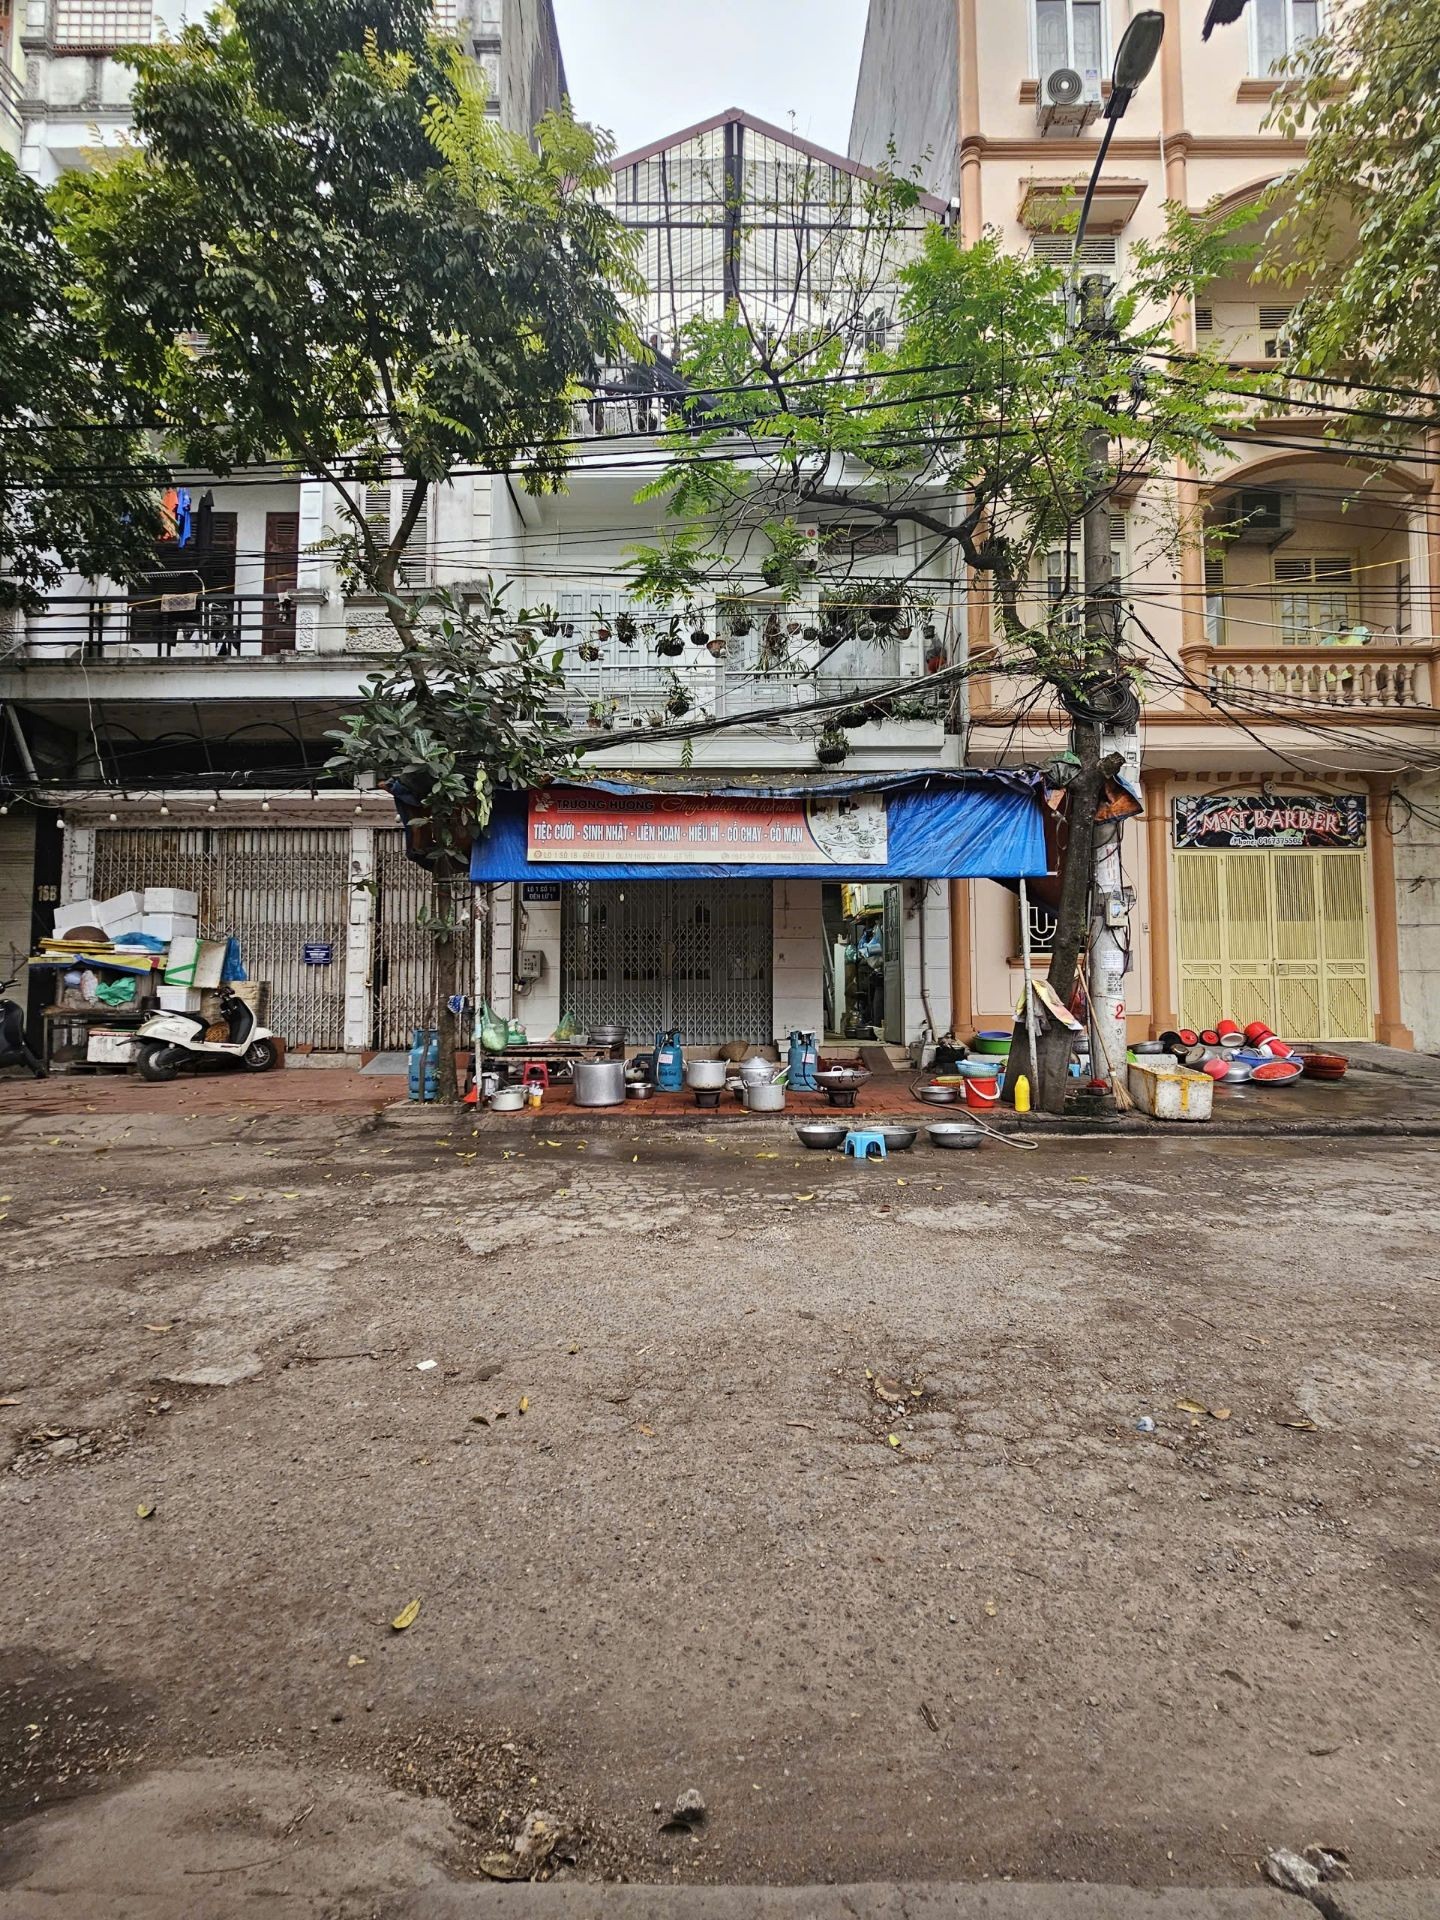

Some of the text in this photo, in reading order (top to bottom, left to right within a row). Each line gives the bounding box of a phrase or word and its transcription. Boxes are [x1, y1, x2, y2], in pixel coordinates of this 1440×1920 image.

[1254, 809, 1341, 833] BARBER
[534, 821, 552, 843] TIỆC
[554, 821, 575, 841] CƯỚI
[582, 825, 604, 841] SINH
[605, 822, 629, 844] NHẬT
[636, 822, 655, 841] LIÊN
[657, 825, 681, 842] HOAN
[688, 821, 708, 842] HIẾU
[741, 826, 762, 842] CHAY
[783, 823, 803, 846] MẶN
[1115, 1004, 1125, 1020] 2
